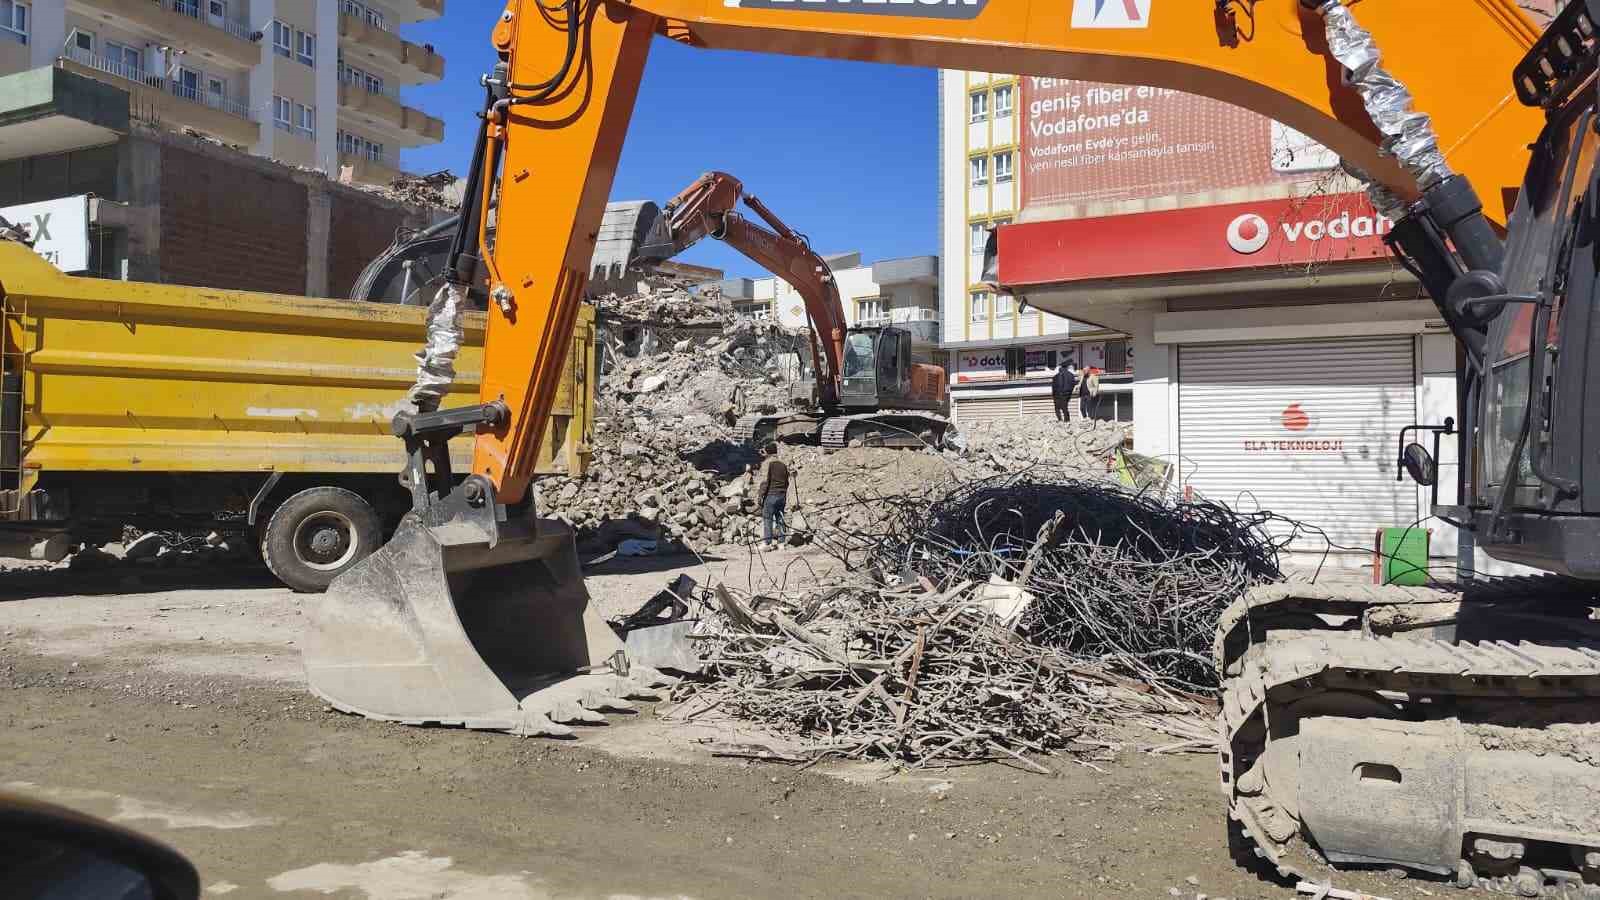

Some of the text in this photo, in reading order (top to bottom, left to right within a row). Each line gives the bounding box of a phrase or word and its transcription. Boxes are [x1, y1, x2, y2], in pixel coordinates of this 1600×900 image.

[1030, 92, 1081, 118] geniş
[1087, 86, 1130, 106] fiber
[1030, 106, 1150, 137] Vodafone'da
[1030, 143, 1082, 158] Vodafone
[1244, 440, 1268, 451] ELA
